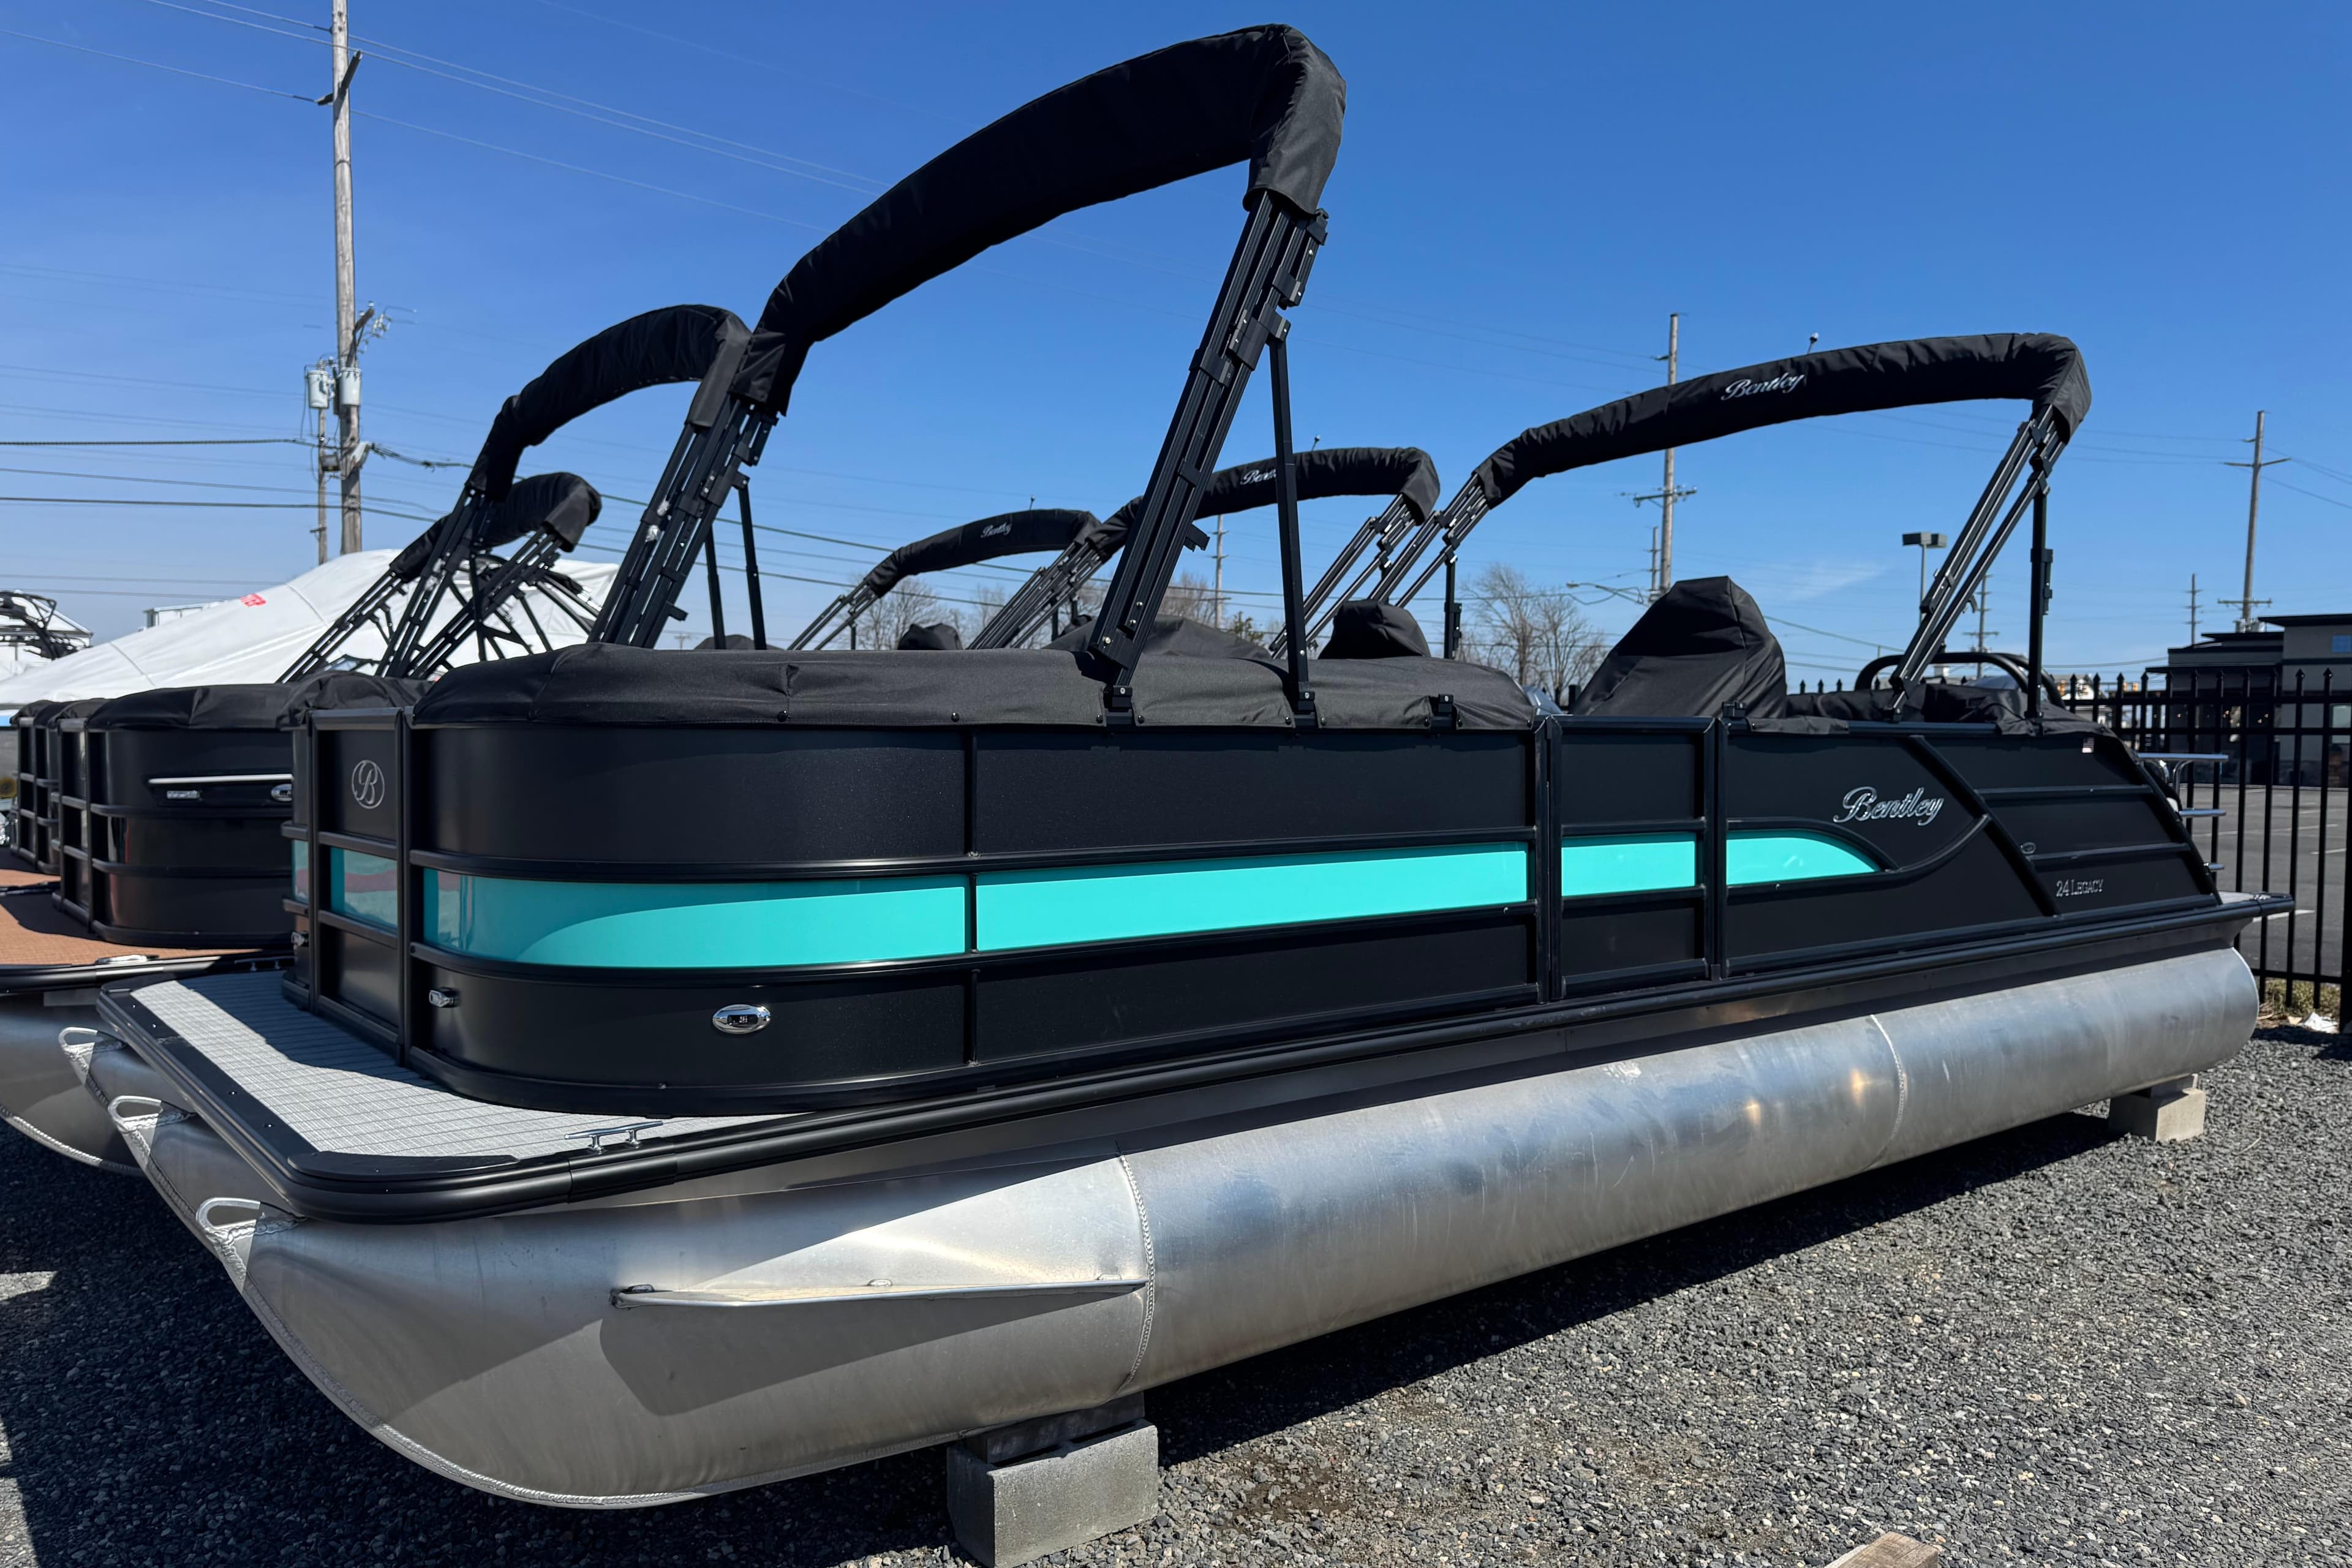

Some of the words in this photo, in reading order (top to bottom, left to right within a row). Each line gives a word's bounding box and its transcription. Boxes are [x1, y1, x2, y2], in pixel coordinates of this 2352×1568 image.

[1721, 372, 1805, 401] Bentley
[1240, 469, 1276, 485] Bent
[1833, 786, 1944, 826] Bentley
[2056, 879, 2070, 897] 24
